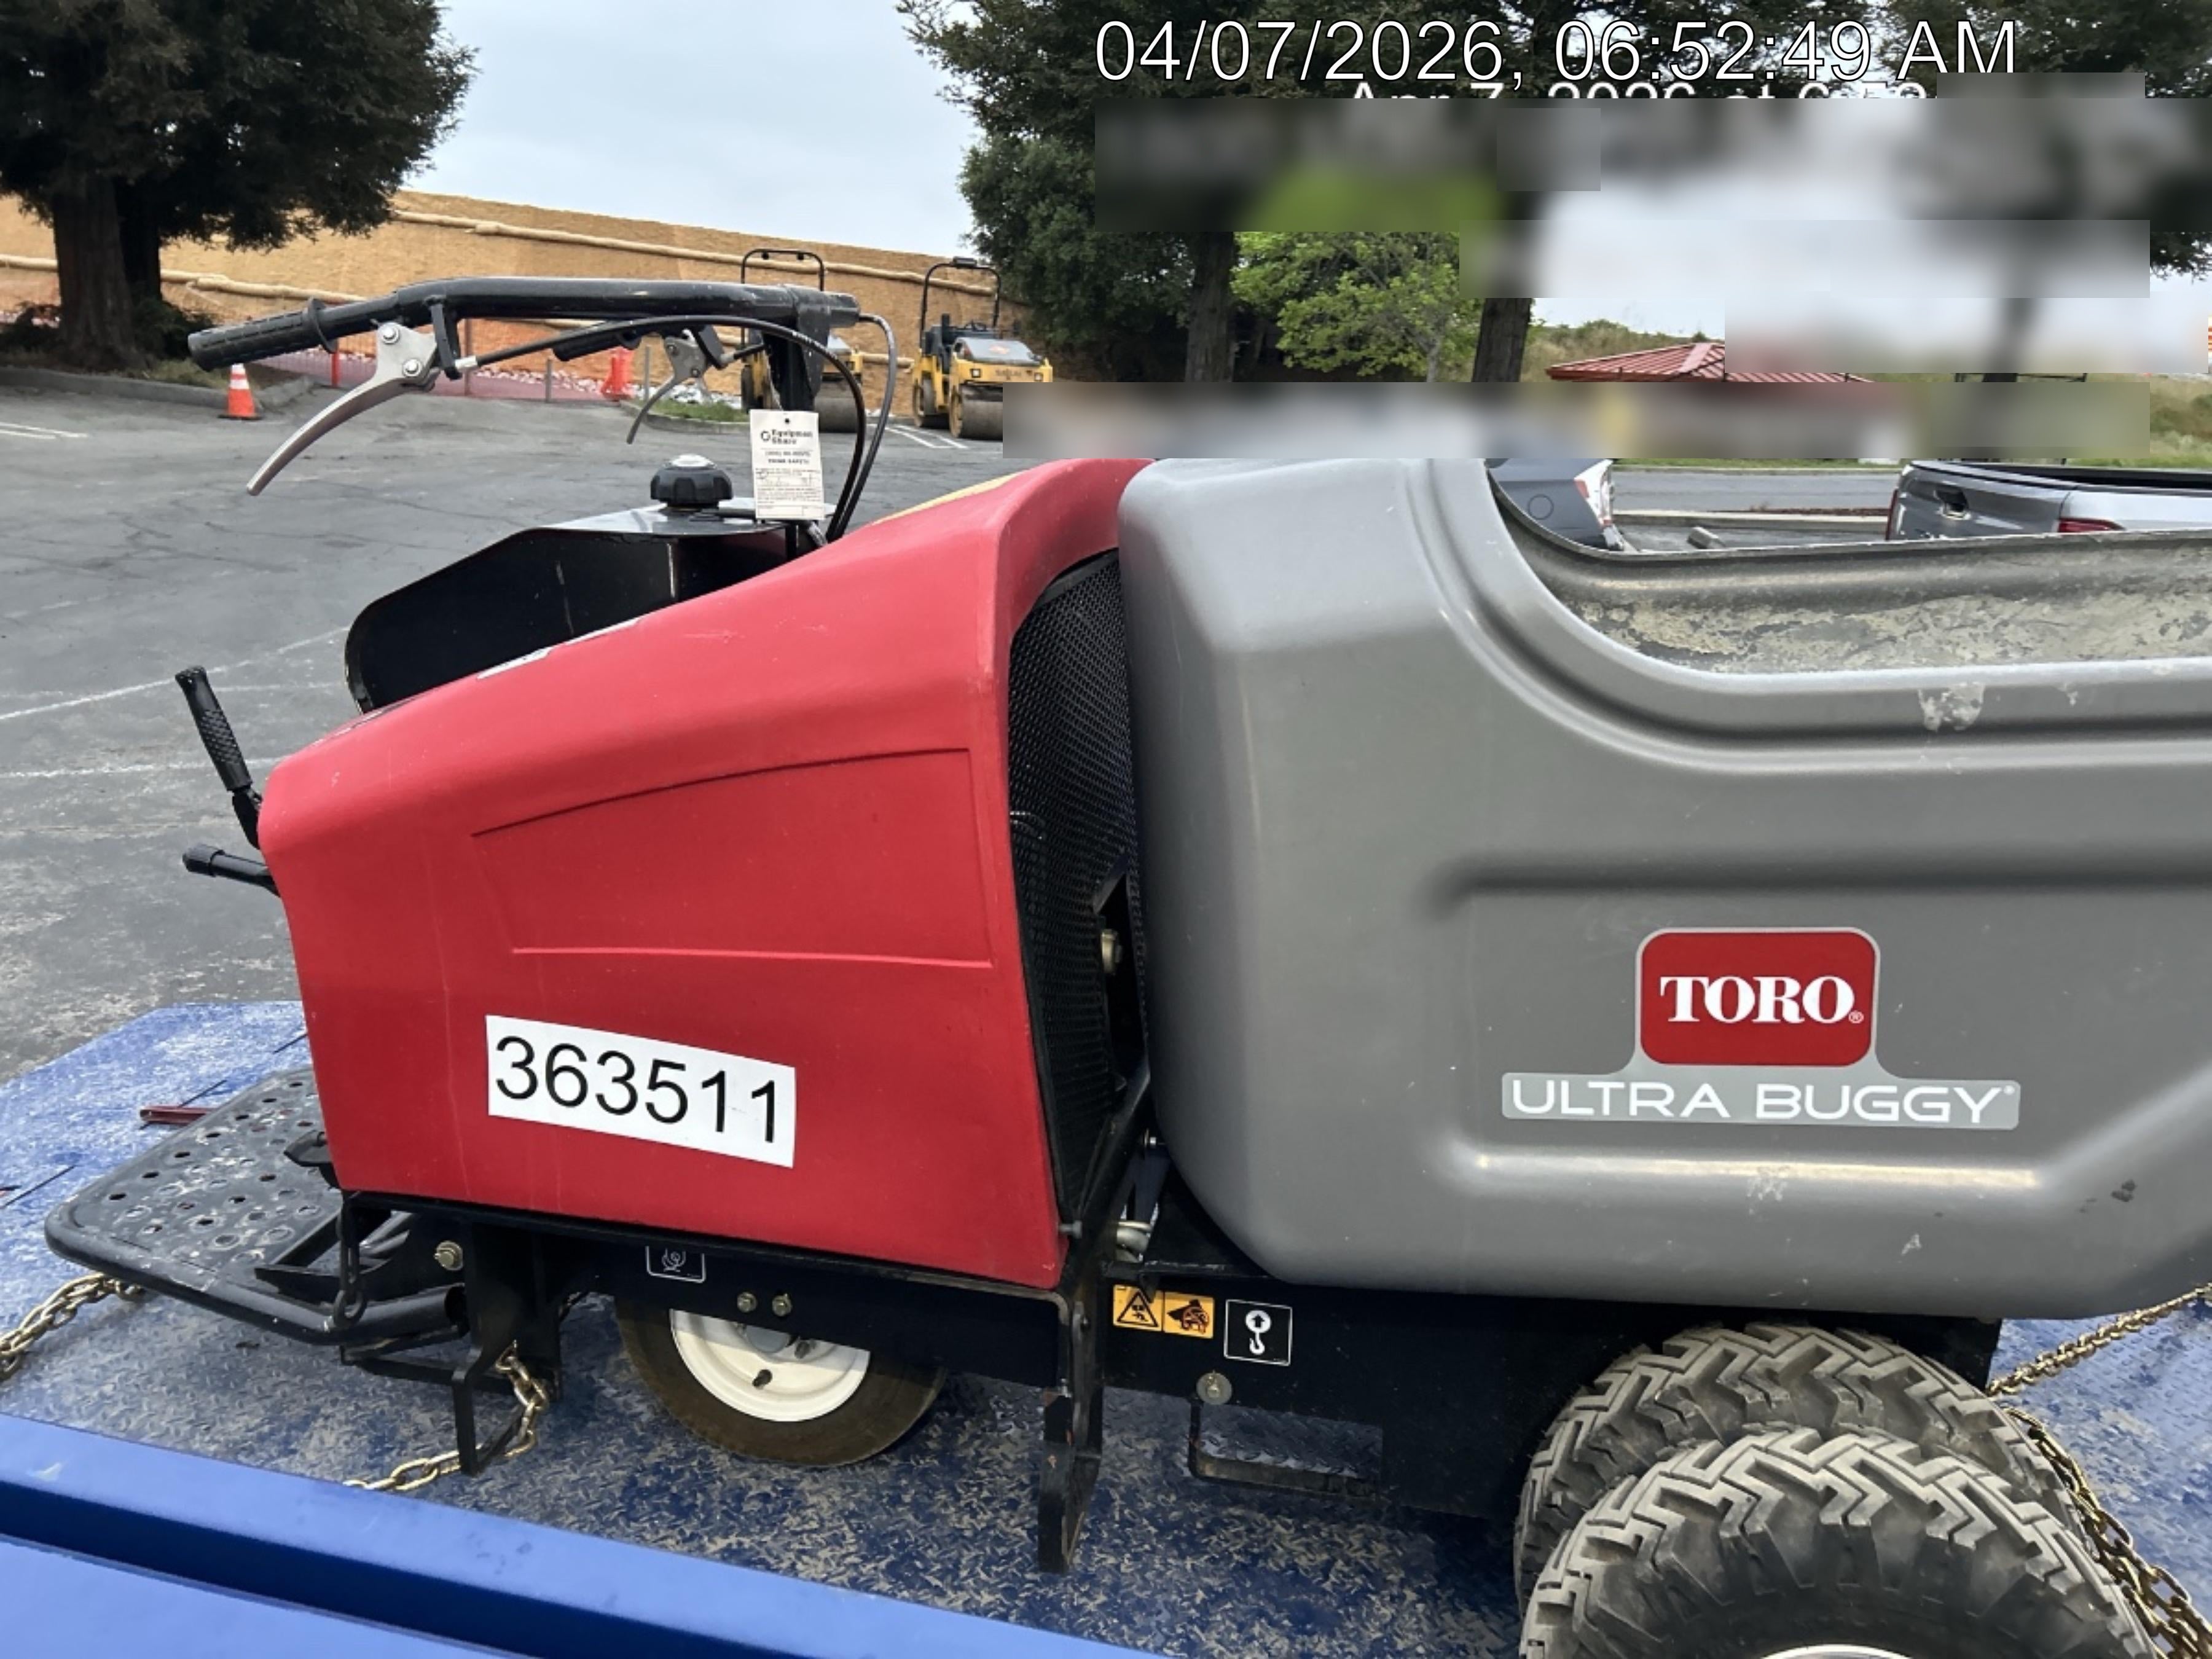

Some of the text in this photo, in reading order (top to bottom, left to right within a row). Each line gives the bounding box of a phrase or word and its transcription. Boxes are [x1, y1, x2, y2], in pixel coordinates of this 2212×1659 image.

[1660, 976, 1854, 1023] TORO
[495, 1035, 775, 1143] 363511
[1512, 1080, 2002, 1123] ULTRA BUGGY
